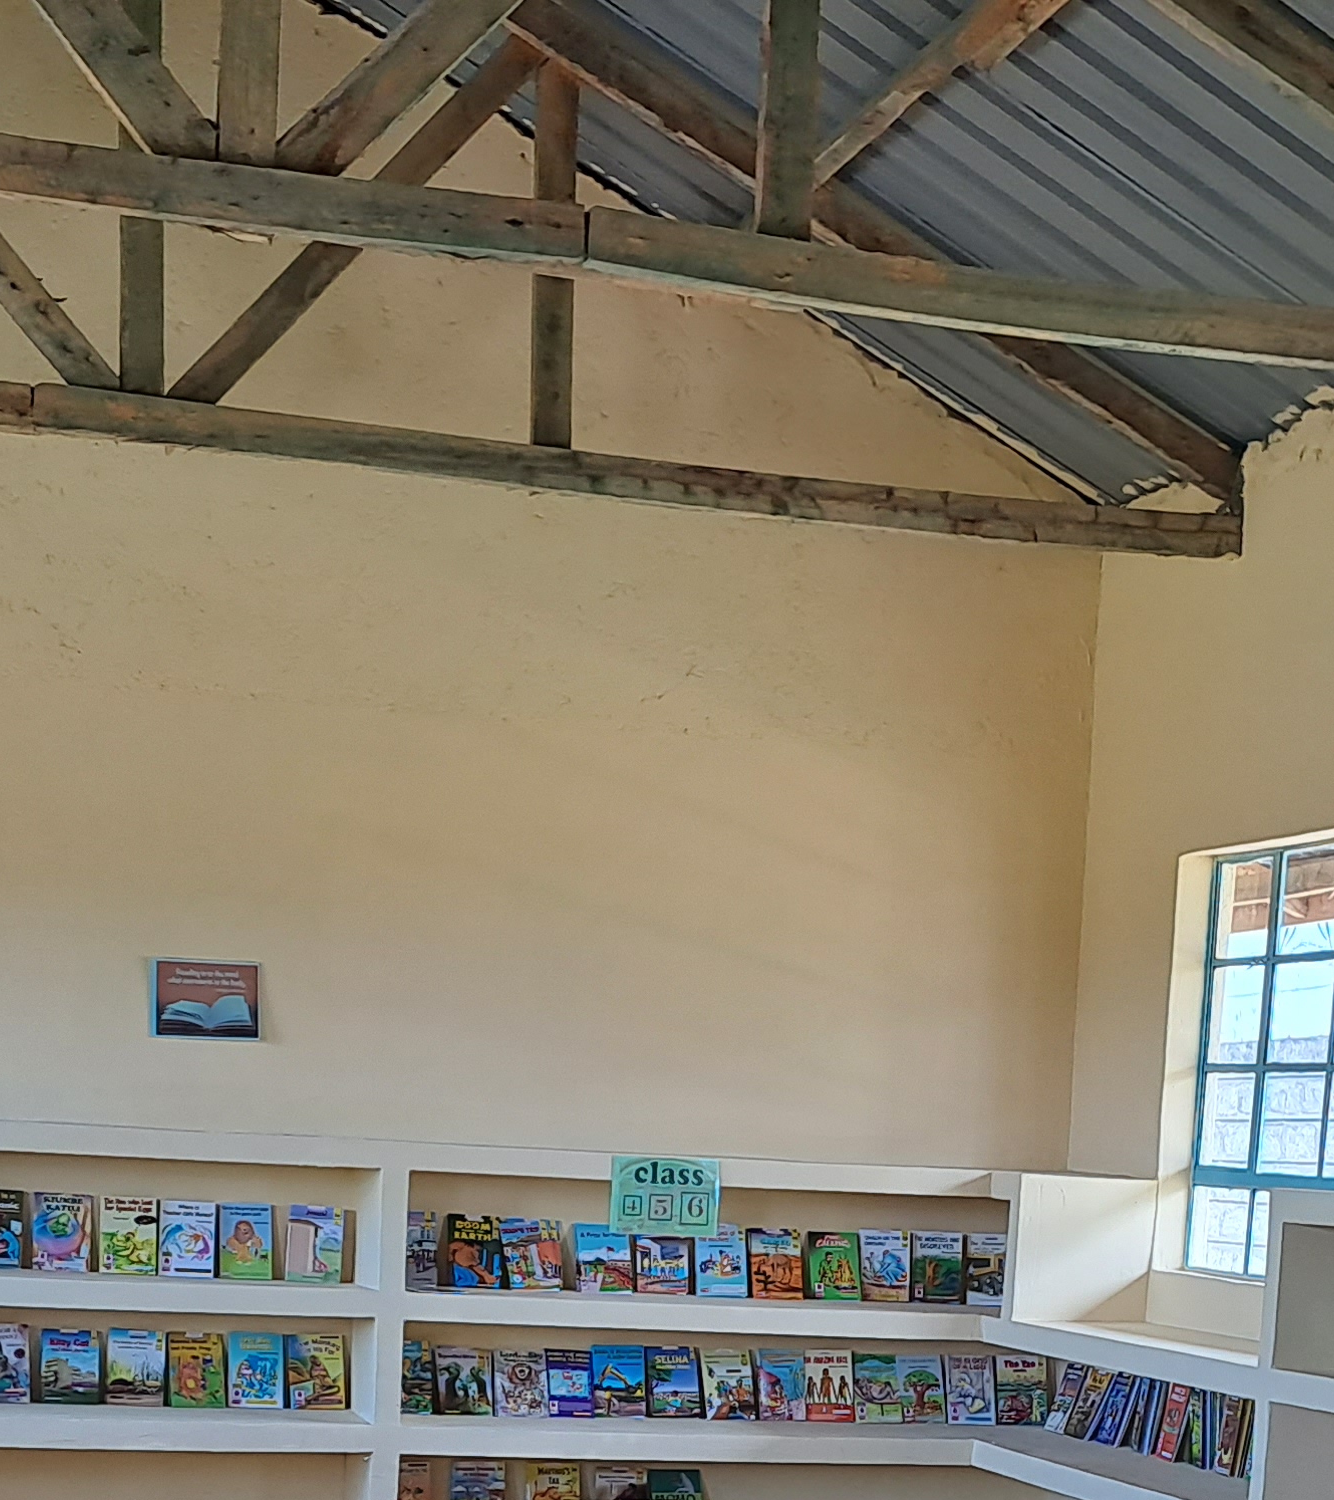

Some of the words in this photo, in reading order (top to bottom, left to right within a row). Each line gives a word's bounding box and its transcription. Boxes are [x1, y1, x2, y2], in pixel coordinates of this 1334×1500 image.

[634, 1161, 704, 1186] class
[627, 1199, 637, 1212] 4
[654, 1199, 667, 1216] 5
[687, 1196, 704, 1218] 6
